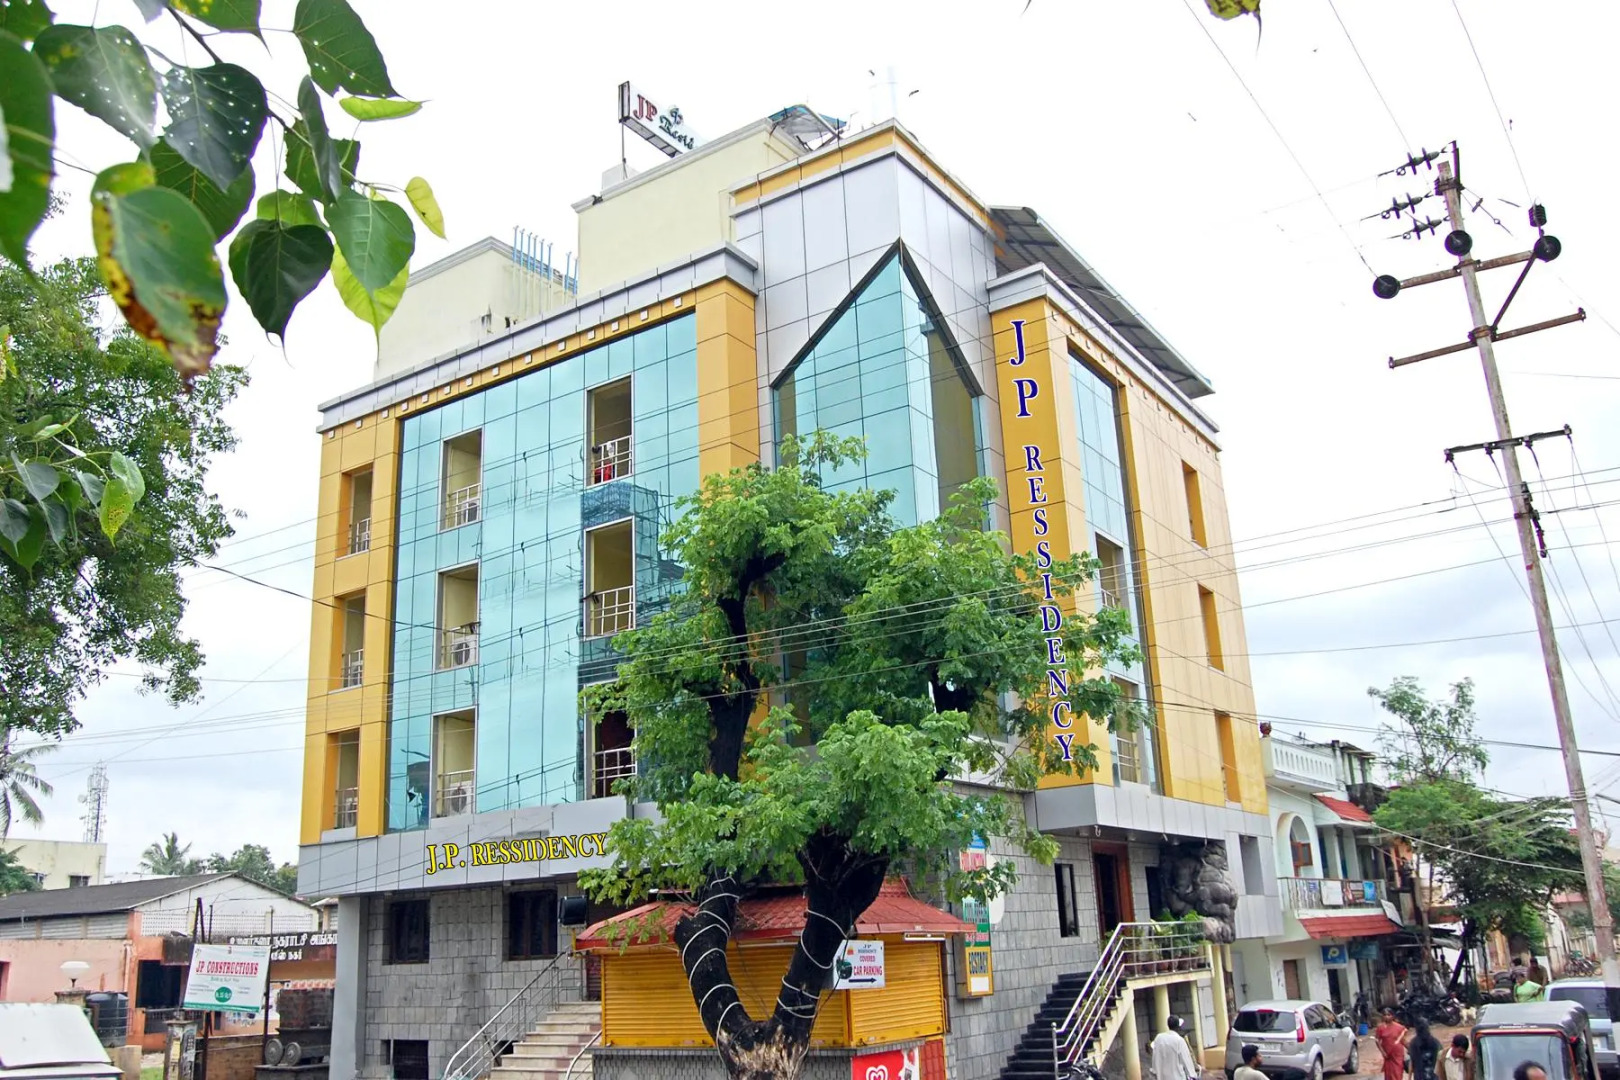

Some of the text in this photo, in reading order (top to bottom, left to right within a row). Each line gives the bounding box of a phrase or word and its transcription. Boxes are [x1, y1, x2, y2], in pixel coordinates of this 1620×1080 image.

[633, 94, 658, 121] JP
[1022, 444, 1075, 762] RESSIDENCY
[426, 832, 608, 875] J.P. RESSIDENCY
[195, 961, 259, 976] JP CONSTRUCTIONS
[863, 965, 883, 976] PARKING
